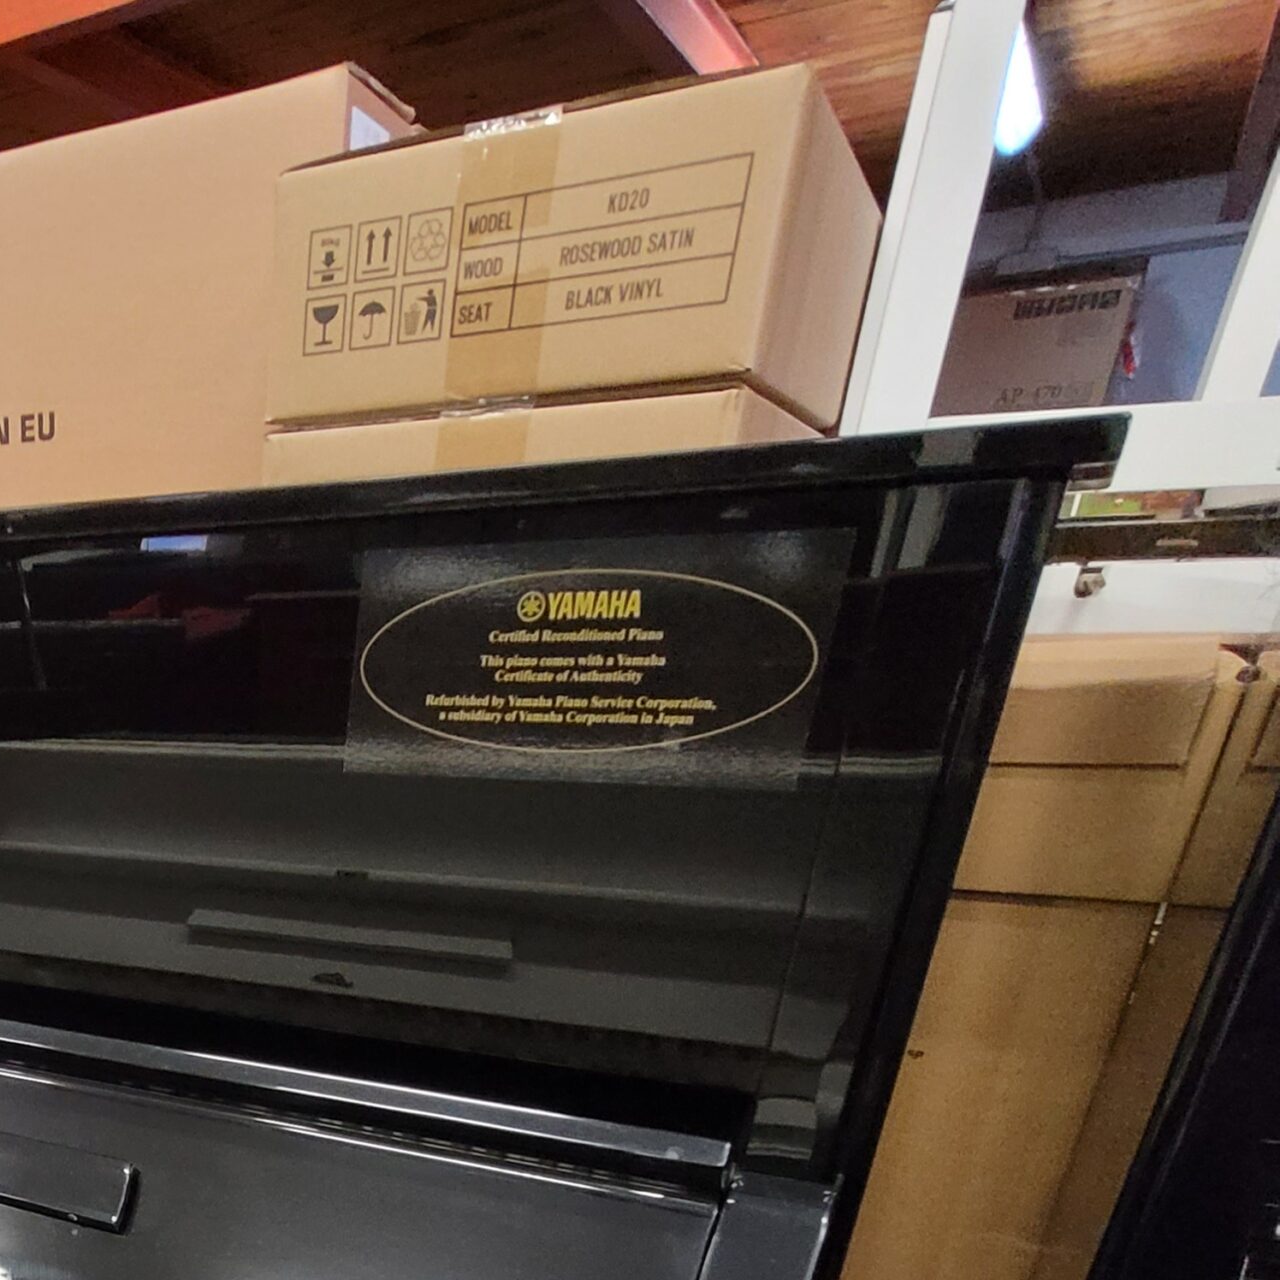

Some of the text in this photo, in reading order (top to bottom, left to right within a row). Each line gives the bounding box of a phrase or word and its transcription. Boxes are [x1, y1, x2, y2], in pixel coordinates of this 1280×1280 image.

[607, 188, 650, 214] KD20
[468, 210, 513, 236] MODEL
[559, 227, 695, 267] ROSEWOOD SATIN
[463, 257, 503, 280] WOOD
[565, 278, 663, 311] BLACK VINYL
[458, 302, 492, 325] SEAT
[20, 411, 55, 443] EU
[547, 589, 642, 620] YAMAHA
[488, 628, 664, 643] Certified Reconditioned Piano
[480, 654, 666, 669] This piano comes with a Yamaha
[494, 669, 644, 685] Certificate of Authenticity
[425, 694, 717, 711] Refurbished by Yamaha Piano Service Corporation,
[448, 709, 503, 724] subsidiary
[504, 710, 517, 722] of
[519, 710, 563, 723] Yamaha
[565, 710, 638, 726] Corporation
[640, 712, 653, 724] in
[655, 712, 694, 727] Japan
